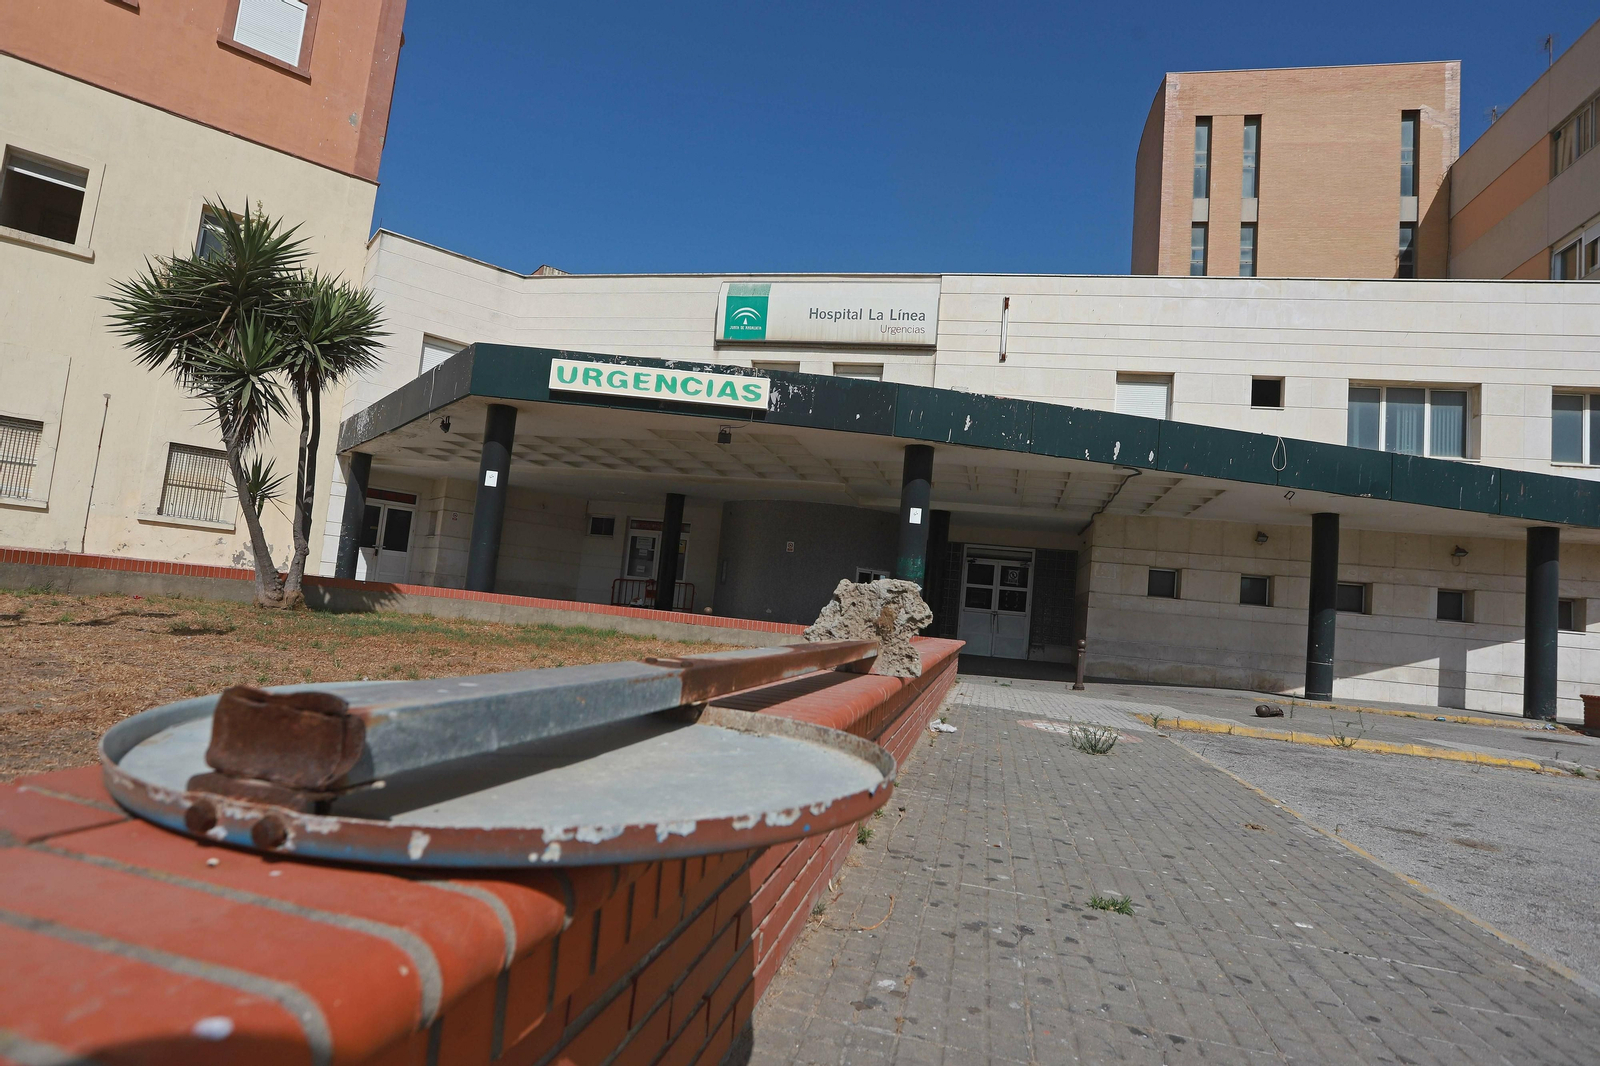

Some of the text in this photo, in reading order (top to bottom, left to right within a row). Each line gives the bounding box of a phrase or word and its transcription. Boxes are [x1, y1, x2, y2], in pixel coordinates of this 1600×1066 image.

[809, 308, 925, 322] Hospital La Línea
[880, 324, 925, 335] Urgencias
[557, 365, 762, 402] URGENCIAS
